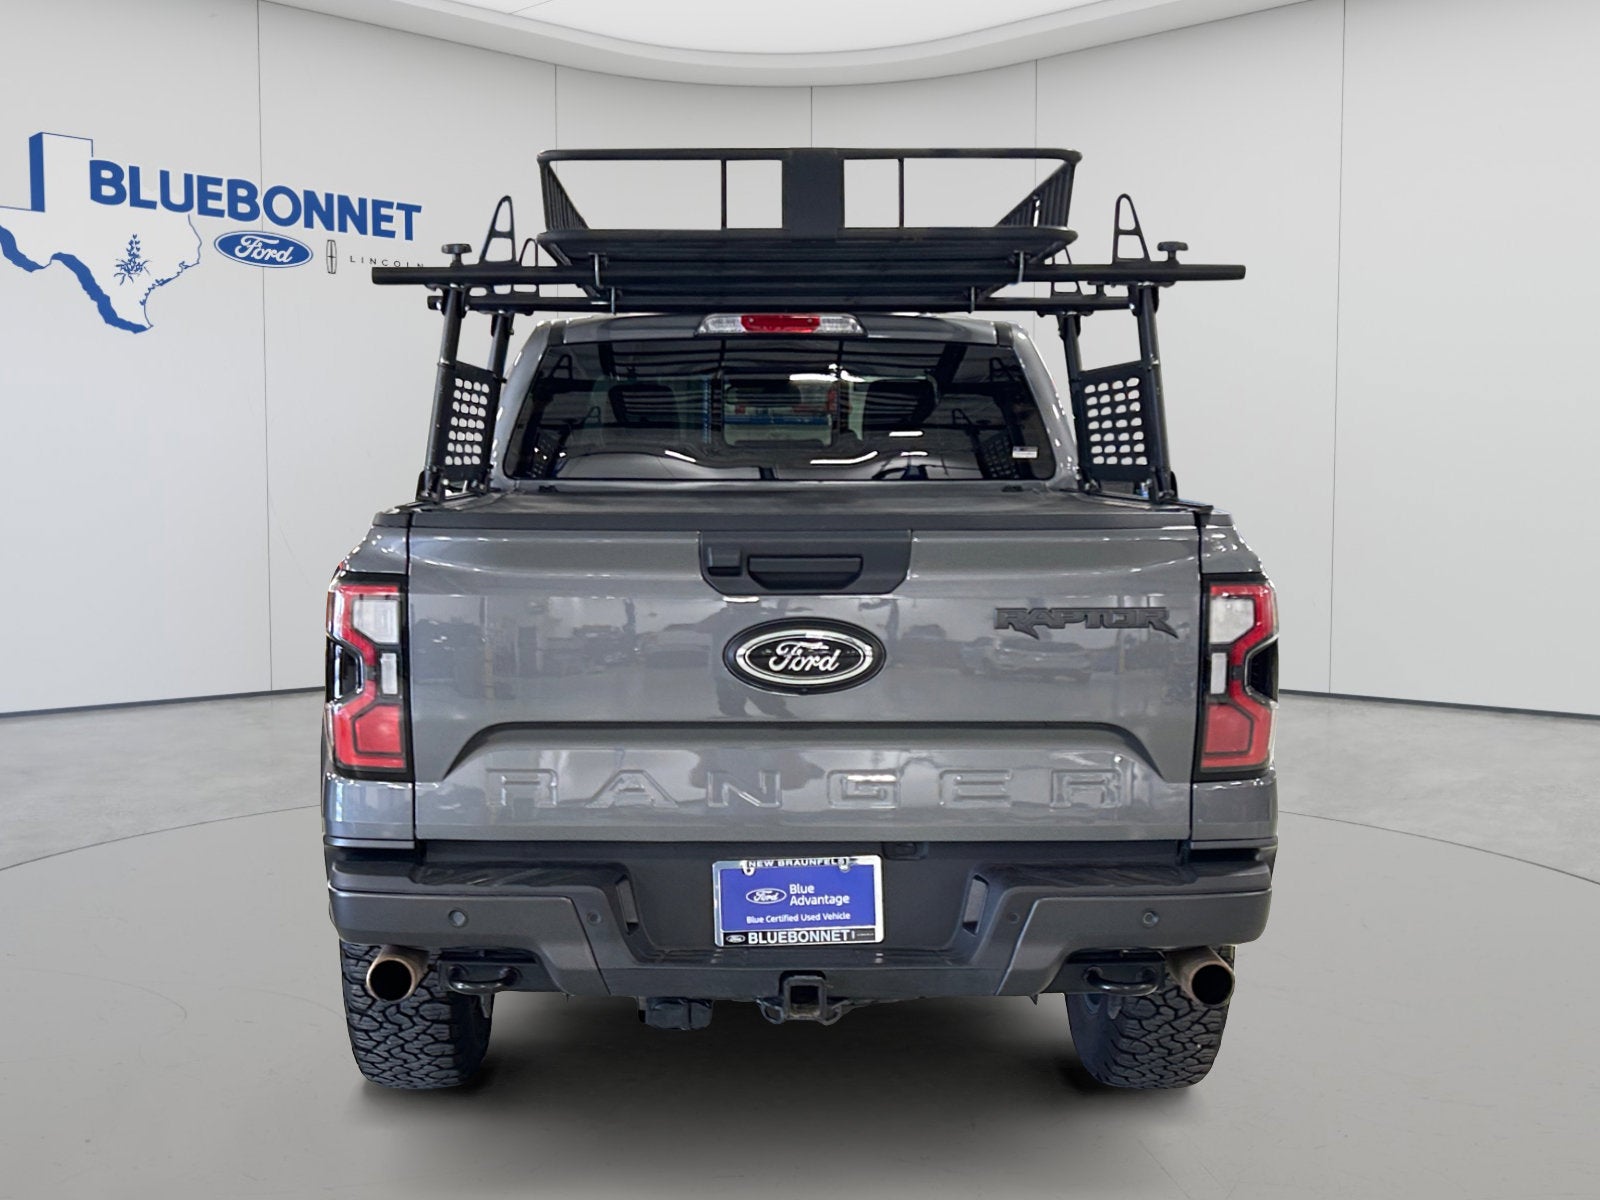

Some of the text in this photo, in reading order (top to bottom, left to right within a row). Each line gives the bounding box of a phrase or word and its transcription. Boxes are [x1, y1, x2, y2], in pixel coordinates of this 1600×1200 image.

[89, 159, 422, 241] BLUEBONNET
[234, 235, 293, 264] Ford
[994, 607, 1179, 640] RAPTOR
[768, 641, 840, 673] Ford
[486, 768, 1122, 810] RANGER
[749, 859, 774, 867] NEW
[753, 890, 779, 902] Ford
[789, 883, 815, 894] Blue
[789, 894, 850, 906] Advantage
[746, 912, 851, 924] Blue Certified Used Vehicle
[748, 929, 849, 944] BLUEBONNET
